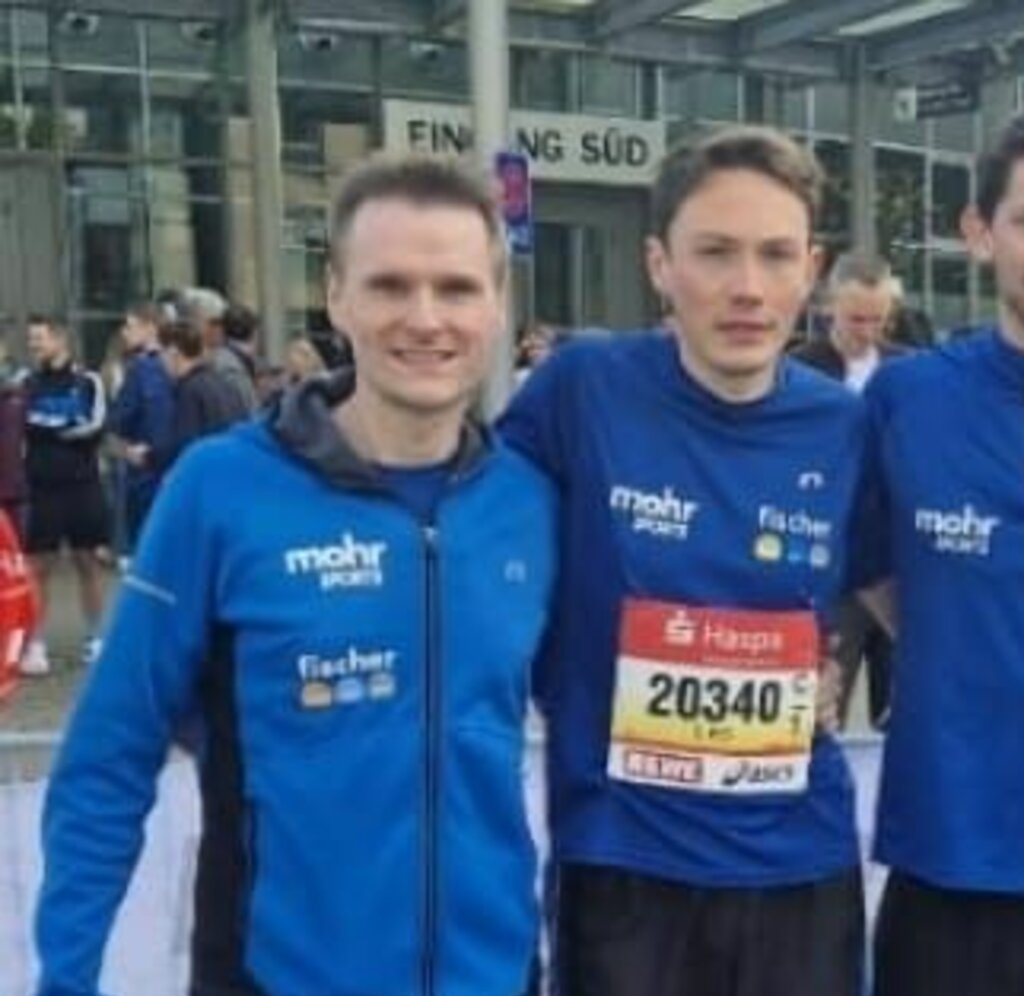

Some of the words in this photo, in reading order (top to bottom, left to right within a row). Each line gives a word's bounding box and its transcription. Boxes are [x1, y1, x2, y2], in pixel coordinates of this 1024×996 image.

[407, 119, 564, 163] EINNG
[580, 126, 649, 167] SÜD
[610, 485, 698, 522] mohr
[758, 504, 831, 539] fischer
[915, 503, 1001, 536] mohr
[284, 531, 387, 574] mohr
[703, 618, 783, 655] Haspa
[297, 647, 397, 679] fischer
[648, 673, 781, 723] 20340
[626, 752, 698, 781] REWE
